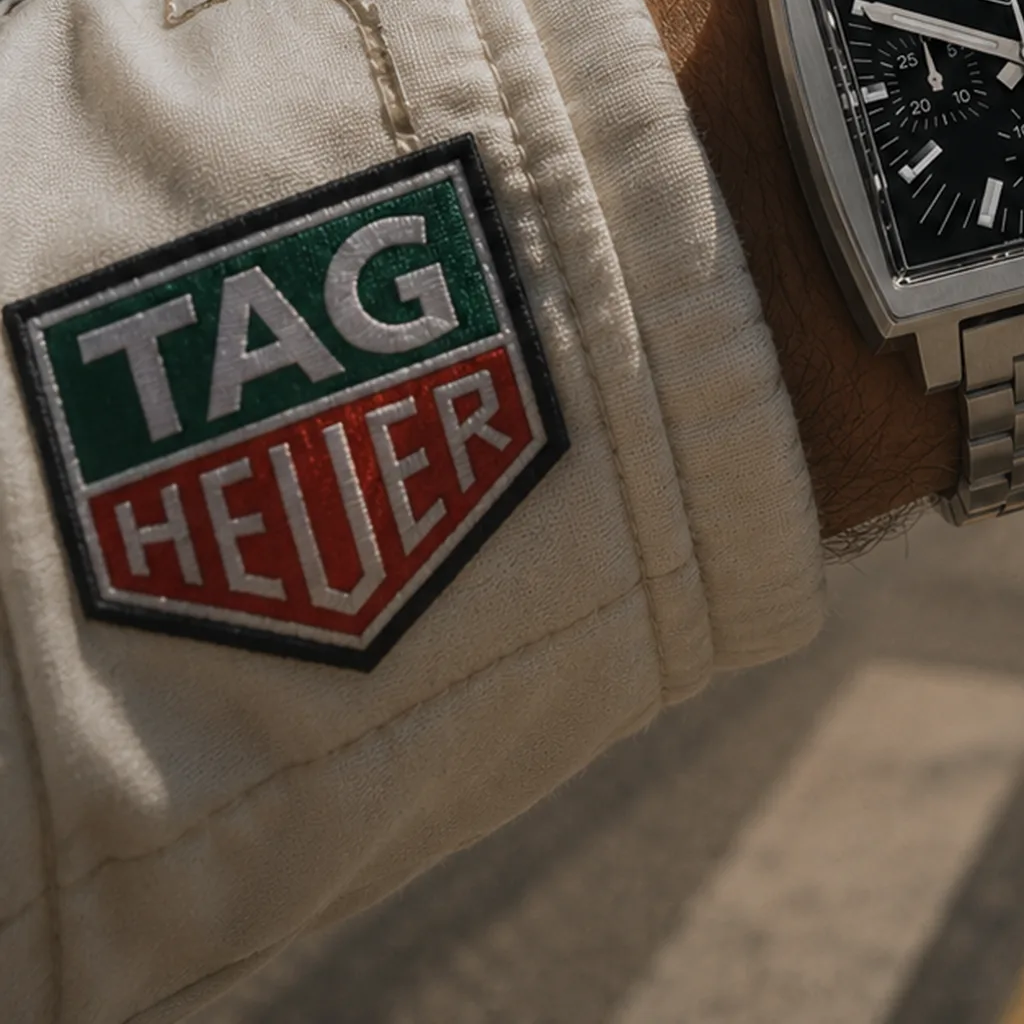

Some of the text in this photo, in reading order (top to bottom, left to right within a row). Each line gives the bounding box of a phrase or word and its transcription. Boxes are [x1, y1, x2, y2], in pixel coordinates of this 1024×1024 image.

[896, 52, 919, 69] 25
[952, 89, 971, 104] 10
[909, 98, 931, 115] 20
[77, 214, 460, 444] TAG
[114, 368, 513, 615] HEUER
